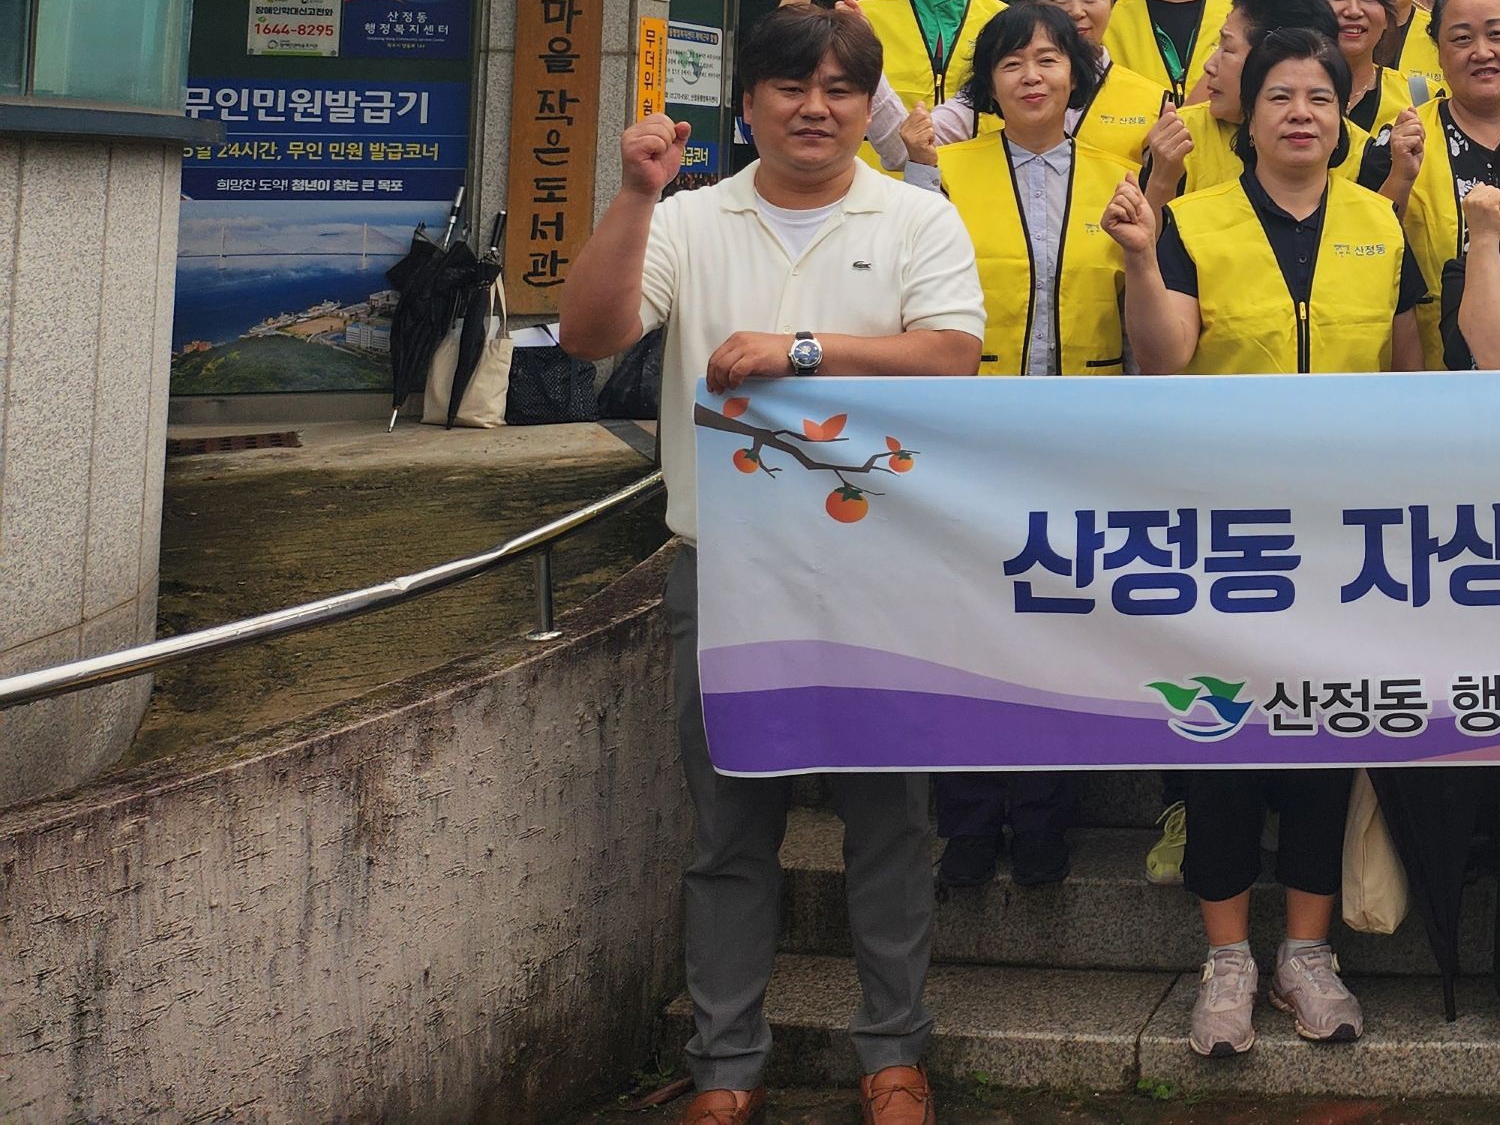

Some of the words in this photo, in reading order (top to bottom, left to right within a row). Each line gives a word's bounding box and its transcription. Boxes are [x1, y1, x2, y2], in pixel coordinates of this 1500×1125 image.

[387, 11, 428, 24] 산정동
[254, 23, 334, 37] 1644-8295
[364, 22, 449, 36] 행정복지센터
[644, 29, 656, 91] 무더위
[186, 87, 429, 124] 무인민원발급기
[287, 144, 322, 160] 무인
[329, 144, 363, 160] 민원
[369, 142, 439, 161] 발급코너
[216, 178, 256, 191] 희망찬
[259, 179, 288, 191] 도약!
[292, 179, 330, 192] 청년이
[333, 179, 359, 192] 찾는
[362, 180, 375, 191] 큰
[377, 179, 403, 192] 목포
[1355, 244, 1386, 256] 산정동
[1003, 508, 1301, 615] 산정동
[1263, 678, 1427, 733] 산정동
